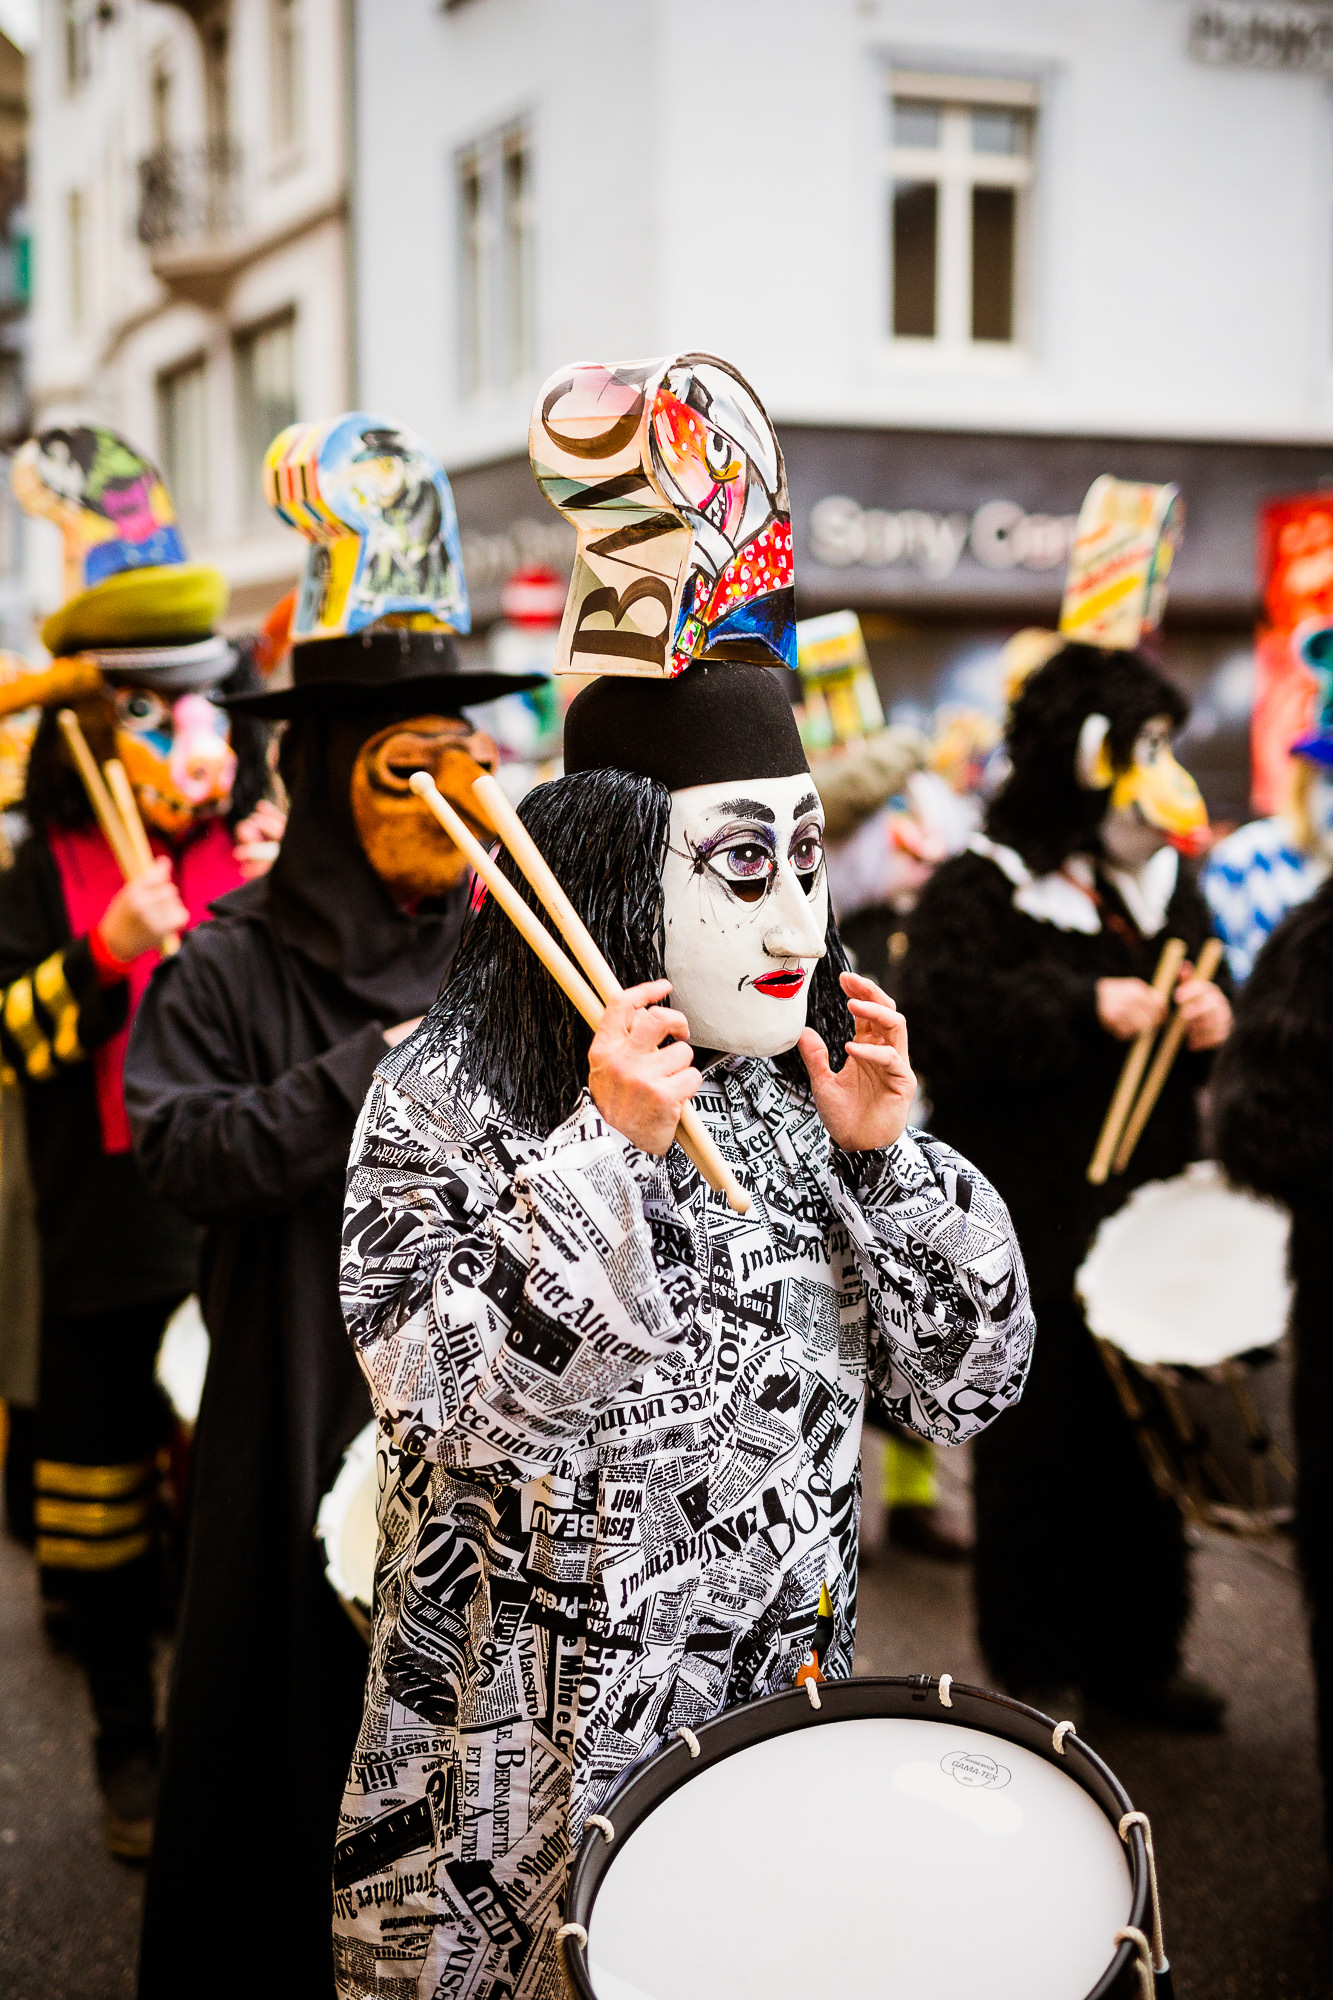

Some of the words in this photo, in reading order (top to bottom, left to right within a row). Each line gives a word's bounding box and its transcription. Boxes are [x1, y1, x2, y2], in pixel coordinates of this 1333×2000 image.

[811, 496, 968, 580] Sony
[417, 1604, 440, 1623] met
[435, 1614, 468, 1643] pronkt
[515, 1635, 539, 1717] Maestro
[557, 1654, 583, 1707] Mita
[357, 1750, 393, 1764] VOM
[391, 1741, 430, 1759] BESTE
[432, 1738, 452, 1752] DAS
[465, 1745, 482, 1768] ET
[463, 1770, 480, 1797] LES
[951, 1760, 999, 1782] GAMA-TEX
[492, 1746, 526, 1860] BERNADETTE
